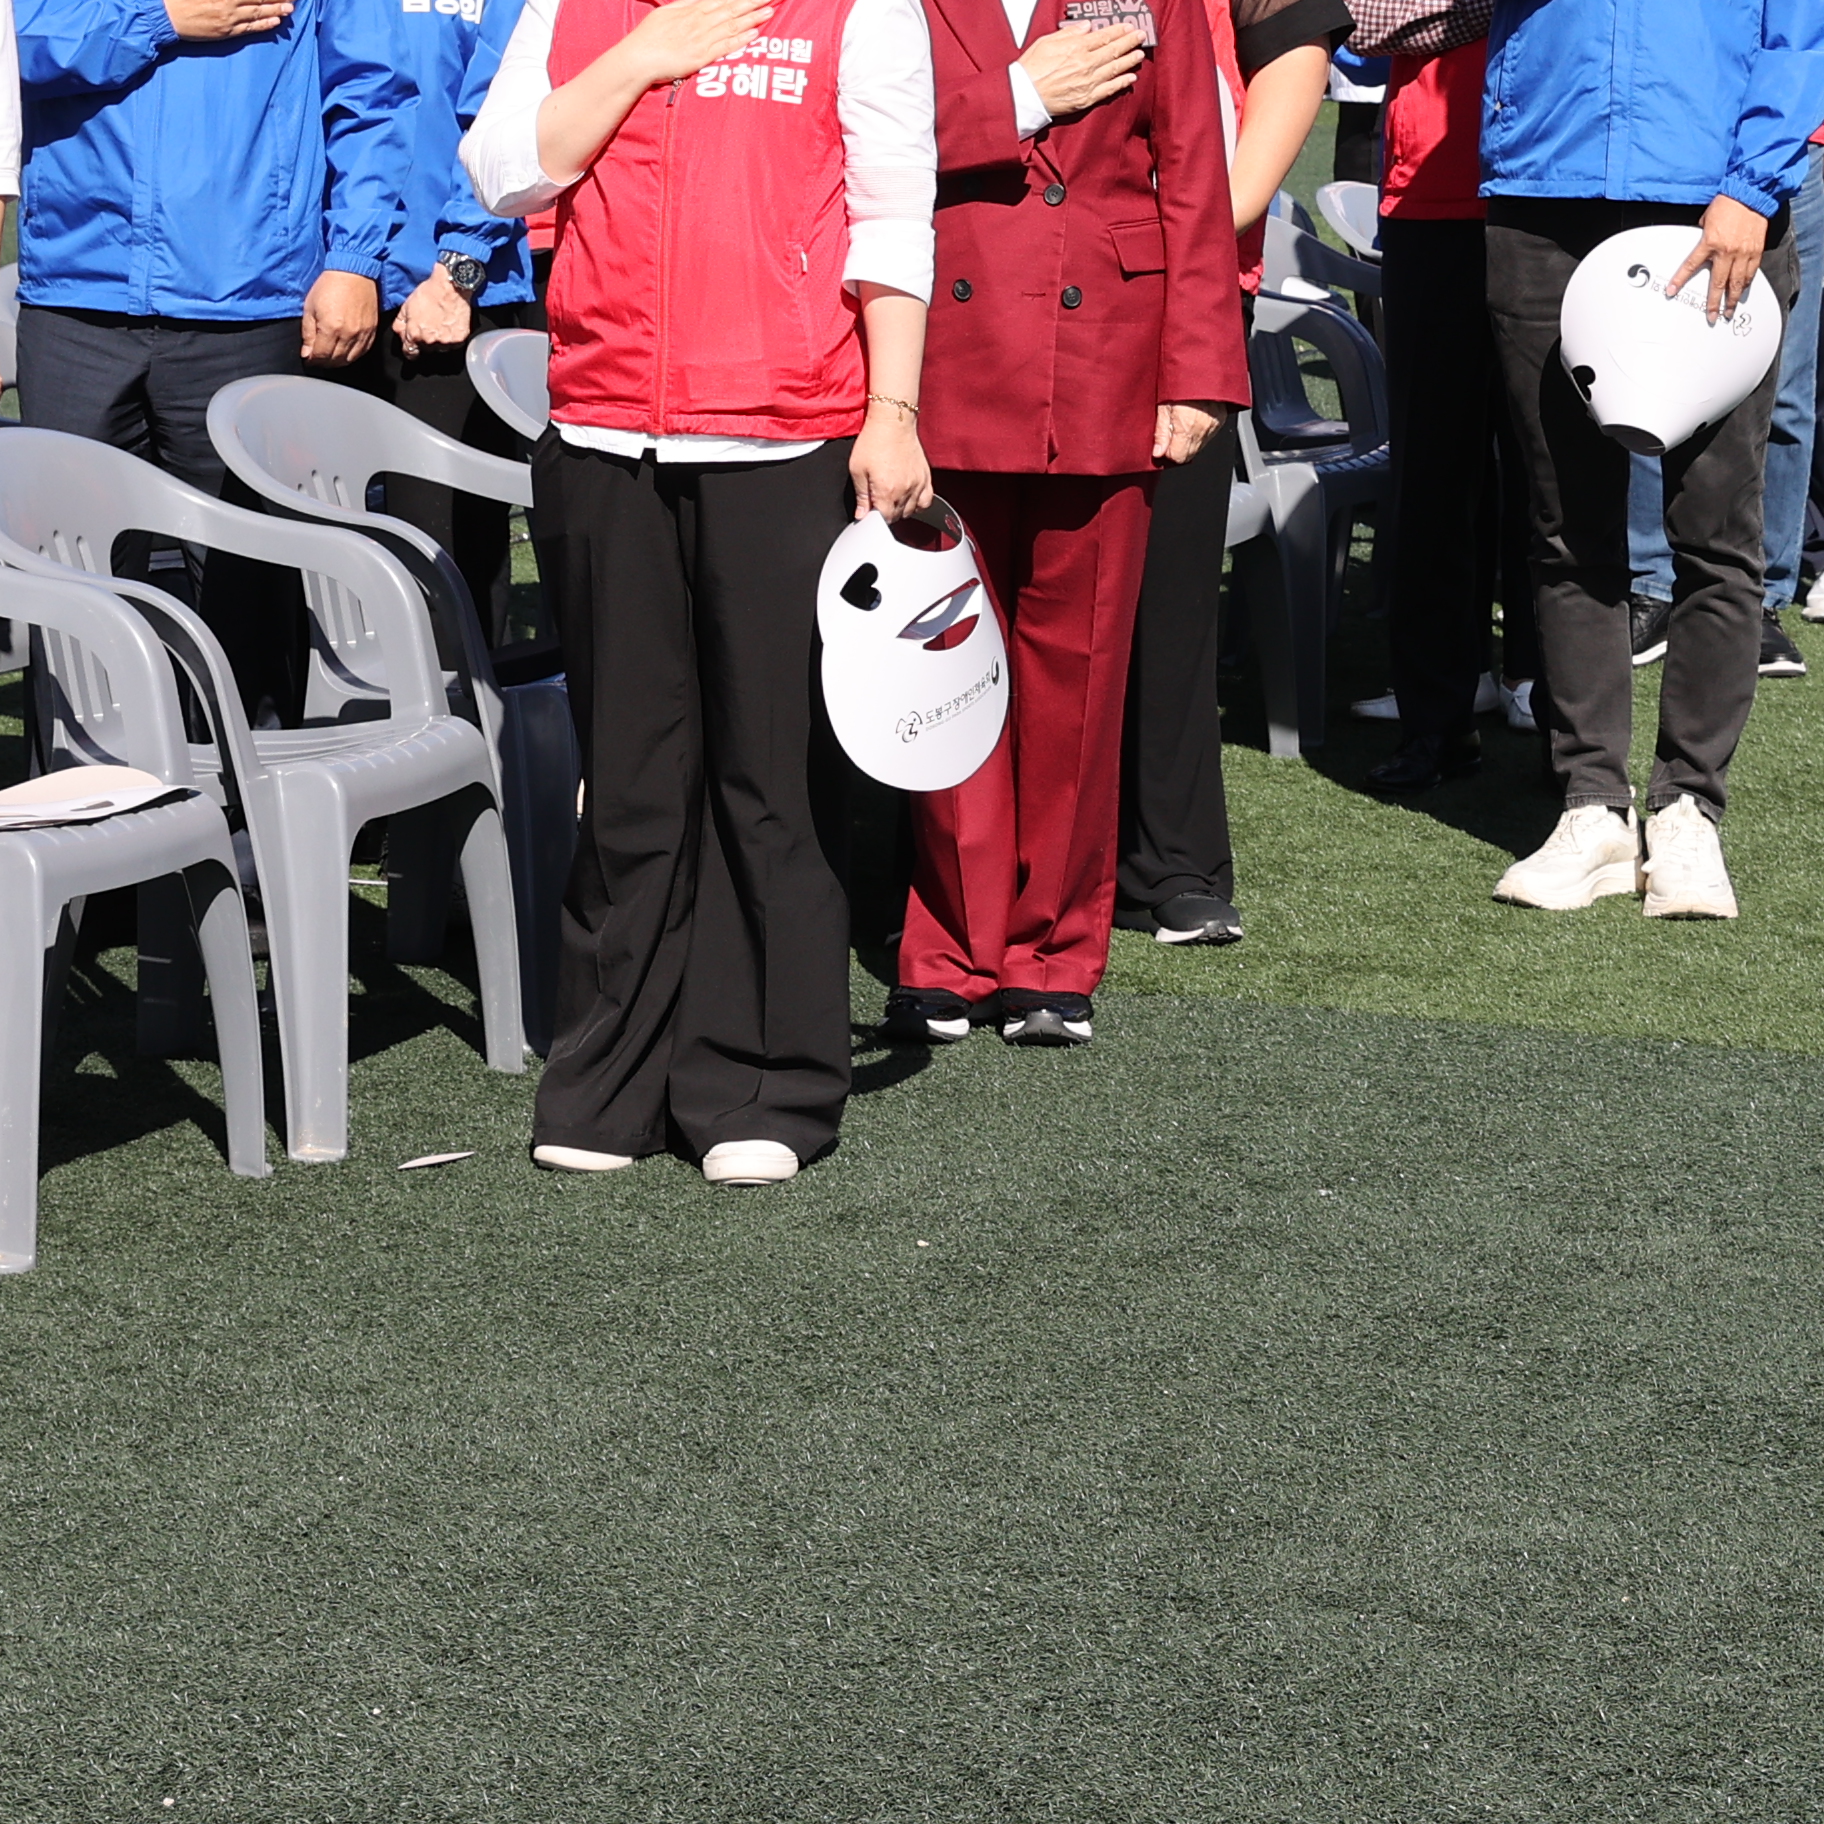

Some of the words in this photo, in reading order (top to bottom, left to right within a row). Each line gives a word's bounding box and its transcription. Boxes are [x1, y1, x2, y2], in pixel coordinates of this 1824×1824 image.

[1066, 0, 1114, 19] 구의원
[716, 35, 814, 64] 구의원
[695, 62, 809, 105] 강혜란
